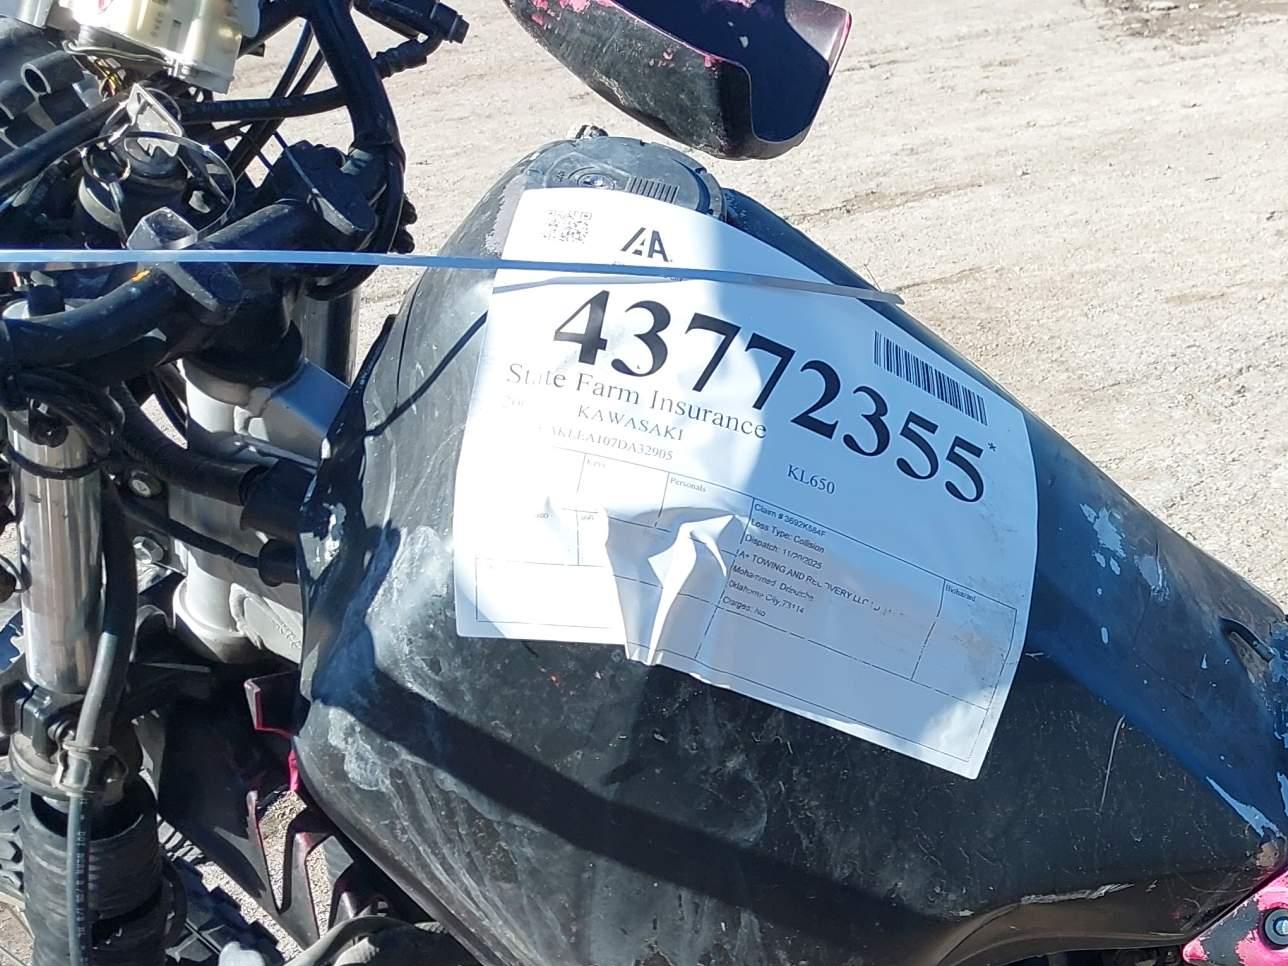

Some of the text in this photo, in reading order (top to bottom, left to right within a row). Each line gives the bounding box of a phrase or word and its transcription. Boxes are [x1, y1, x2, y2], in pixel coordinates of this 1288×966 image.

[506, 362, 768, 439] Stte Farm Insurance
[577, 404, 684, 441] KAWASAKI
[669, 476, 706, 494] Personals
[787, 464, 836, 496] KL650
[754, 503, 776, 519] Claim
[751, 518, 826, 554] Loss Type: Collision
[752, 553, 786, 574] TOWING
[788, 567, 805, 582] AND
